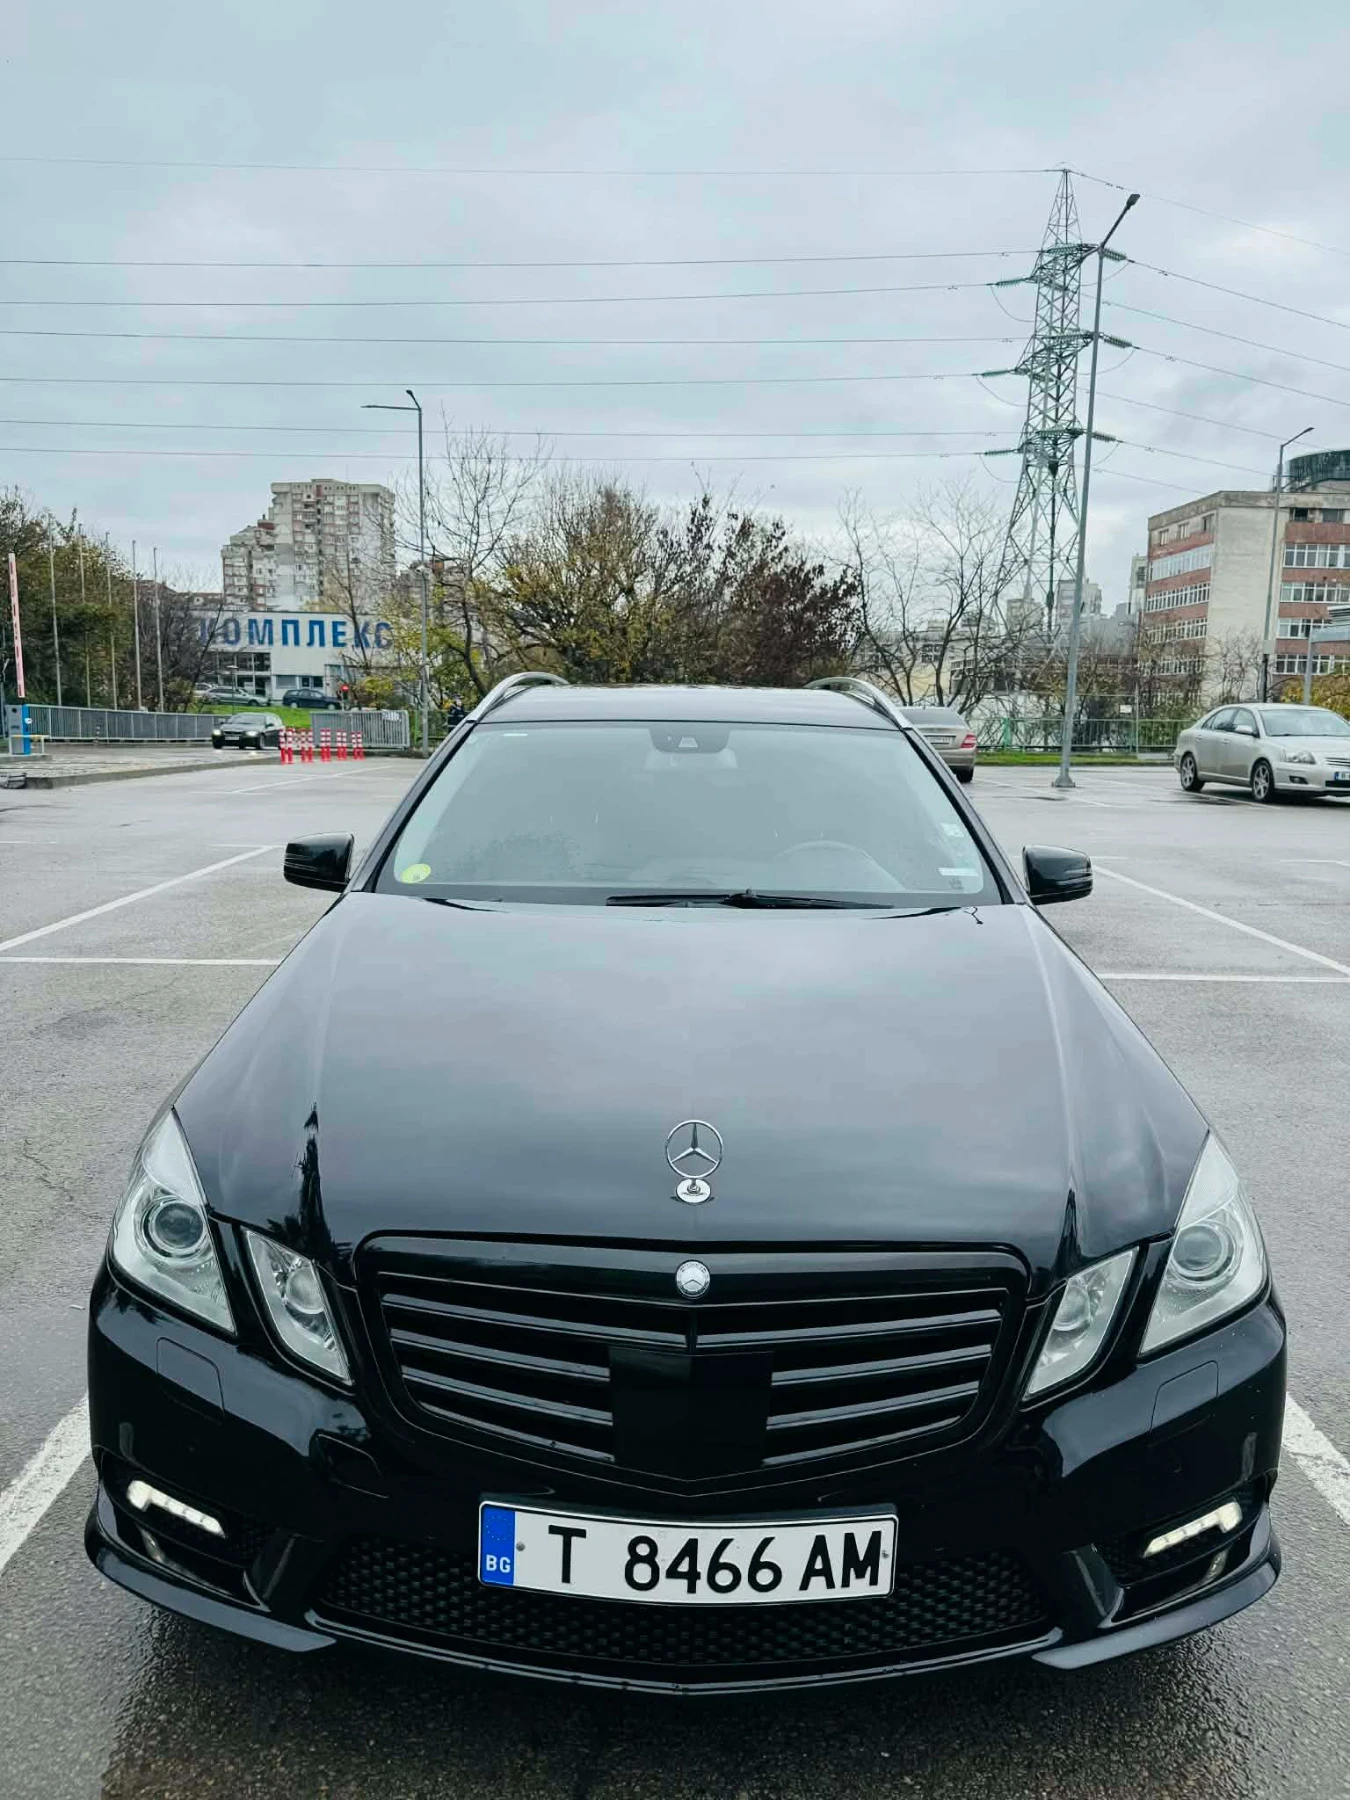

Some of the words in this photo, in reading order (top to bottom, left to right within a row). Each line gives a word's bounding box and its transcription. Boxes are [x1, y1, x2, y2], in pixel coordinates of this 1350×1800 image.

[200, 618, 395, 649] КОМПЛЕКС
[486, 1554, 511, 1574] BG
[548, 1524, 587, 1584] T
[624, 1535, 783, 1594] 8466
[799, 1530, 882, 1591] AM
